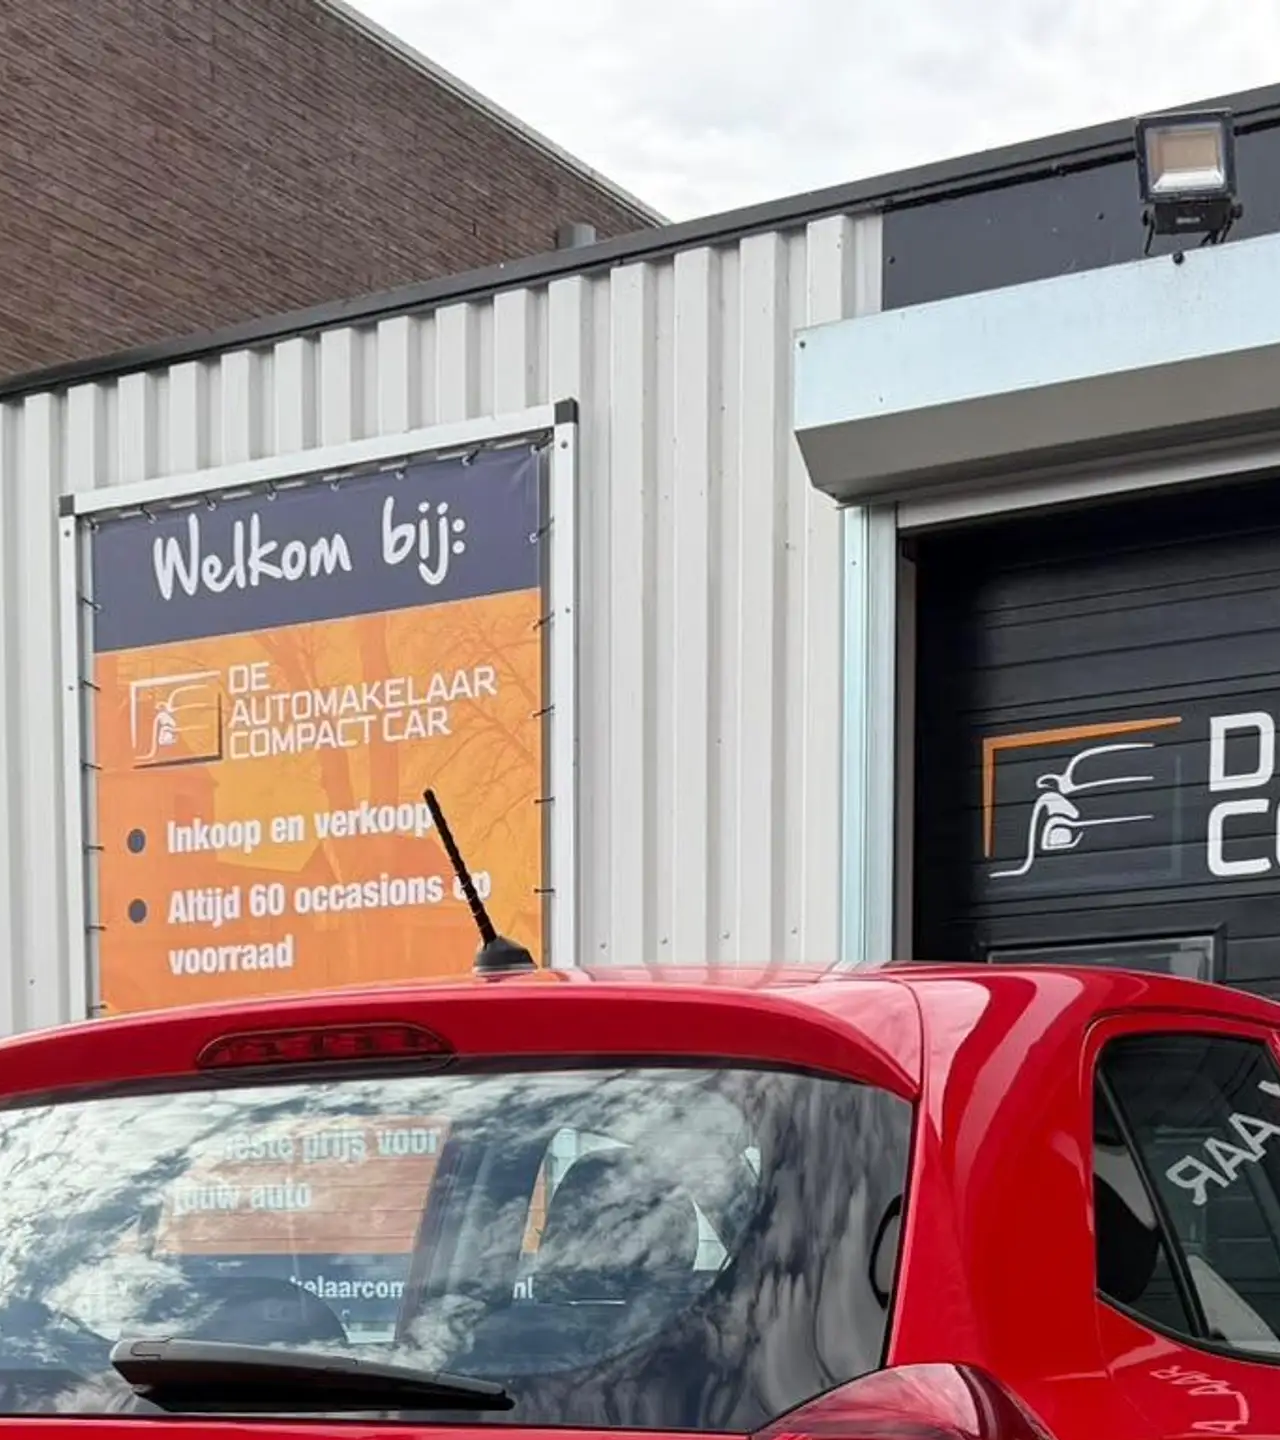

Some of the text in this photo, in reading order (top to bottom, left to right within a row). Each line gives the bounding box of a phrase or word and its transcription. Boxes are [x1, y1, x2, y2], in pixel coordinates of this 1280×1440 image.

[153, 496, 466, 601] Welkom bij:
[229, 661, 270, 694] DE
[229, 666, 498, 729] AUTOMAKELAAR
[229, 707, 451, 760] COMPACT CAR
[167, 800, 433, 854] Inkoop en verkoop
[167, 886, 241, 928] Altijd
[249, 883, 285, 917] 60
[294, 873, 444, 914] occasions
[168, 934, 294, 977] voorraad
[378, 1126, 440, 1155] voor
